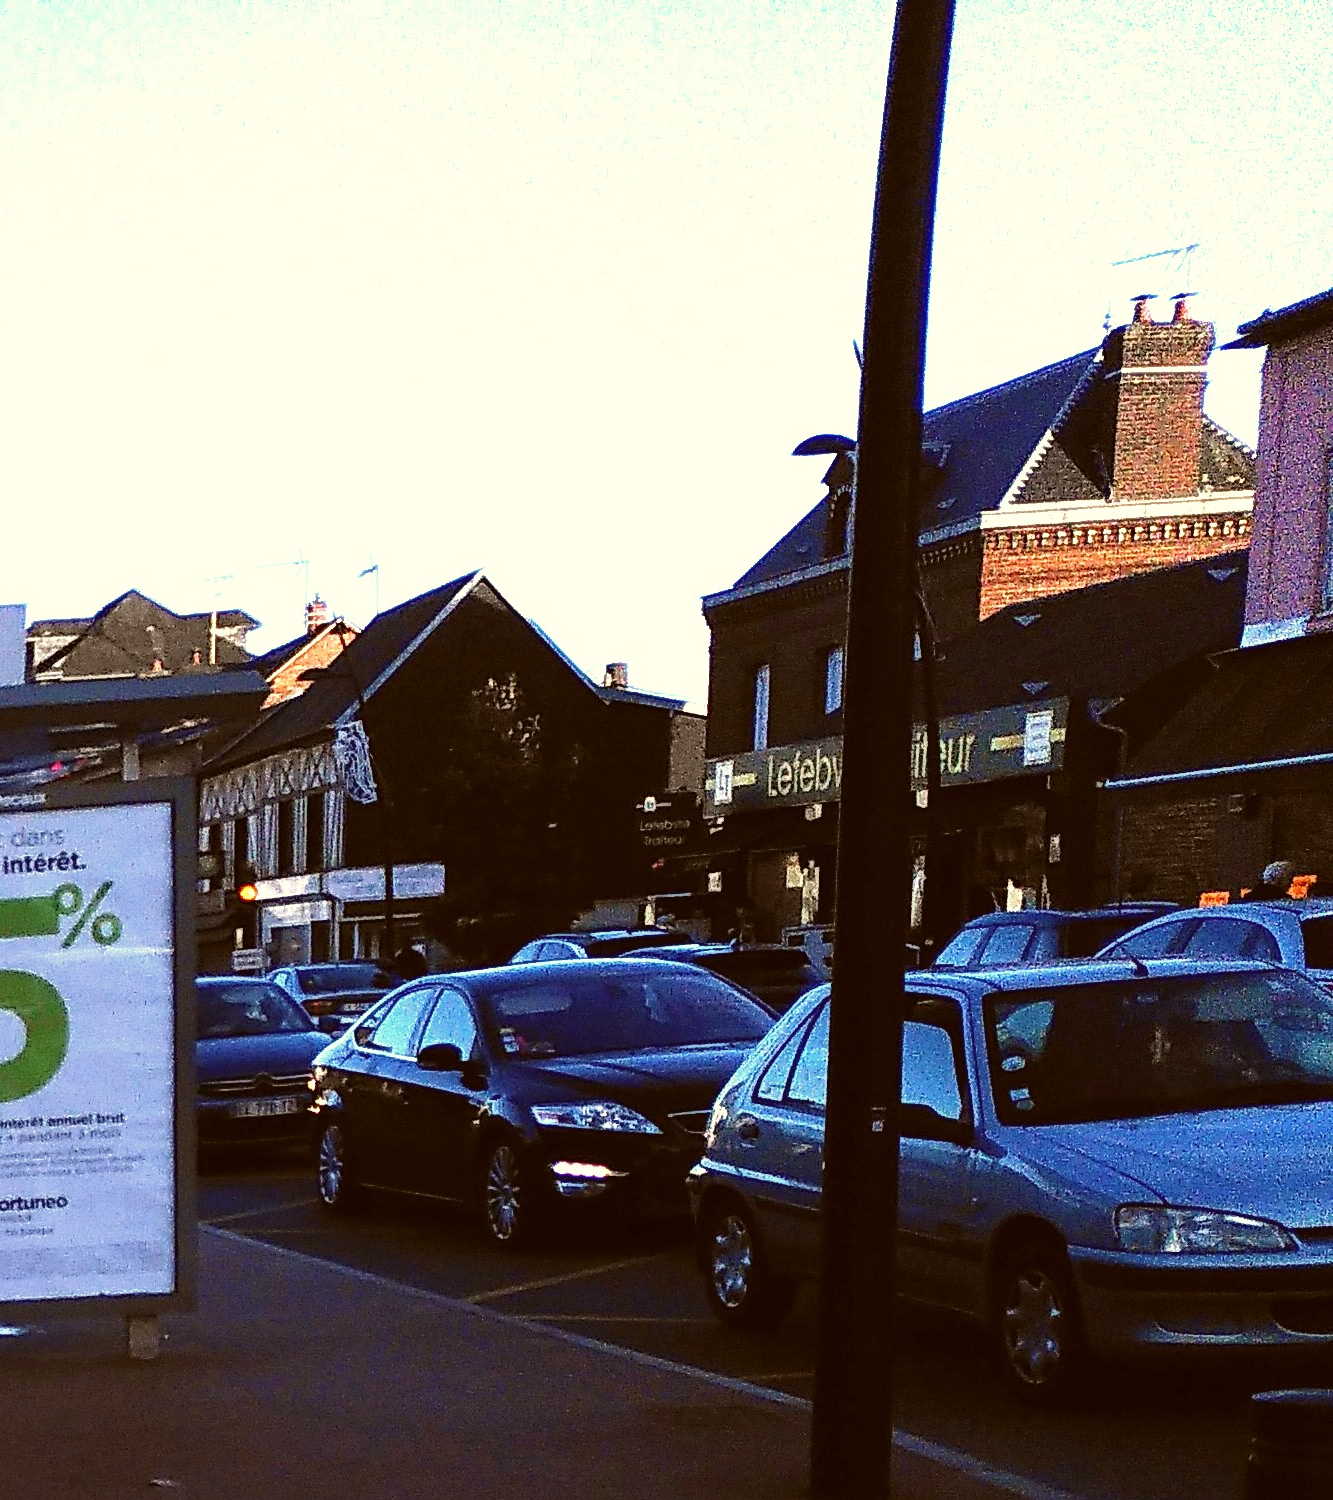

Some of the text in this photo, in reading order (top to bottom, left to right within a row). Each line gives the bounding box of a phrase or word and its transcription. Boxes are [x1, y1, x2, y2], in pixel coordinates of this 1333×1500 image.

[768, 748, 842, 797] Lefebv
[10, 825, 66, 848] dans
[3, 850, 88, 876] intérêt.
